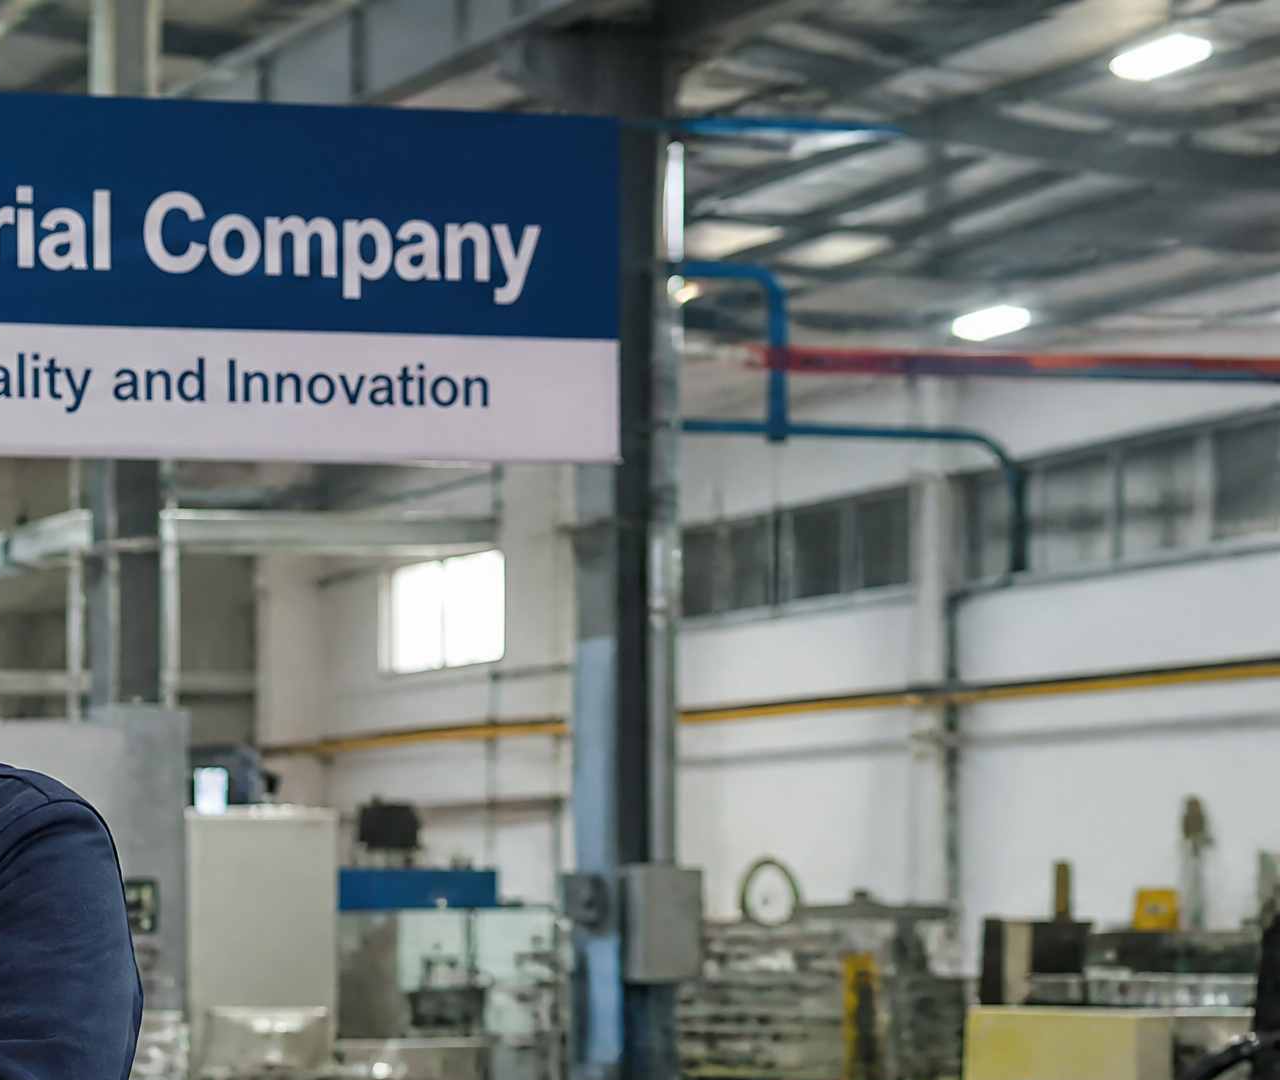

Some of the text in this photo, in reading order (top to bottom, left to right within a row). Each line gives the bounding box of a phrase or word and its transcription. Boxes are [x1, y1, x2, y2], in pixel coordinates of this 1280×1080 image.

[143, 191, 541, 304] Company
[112, 356, 206, 403] and
[227, 358, 489, 408] Innovation
